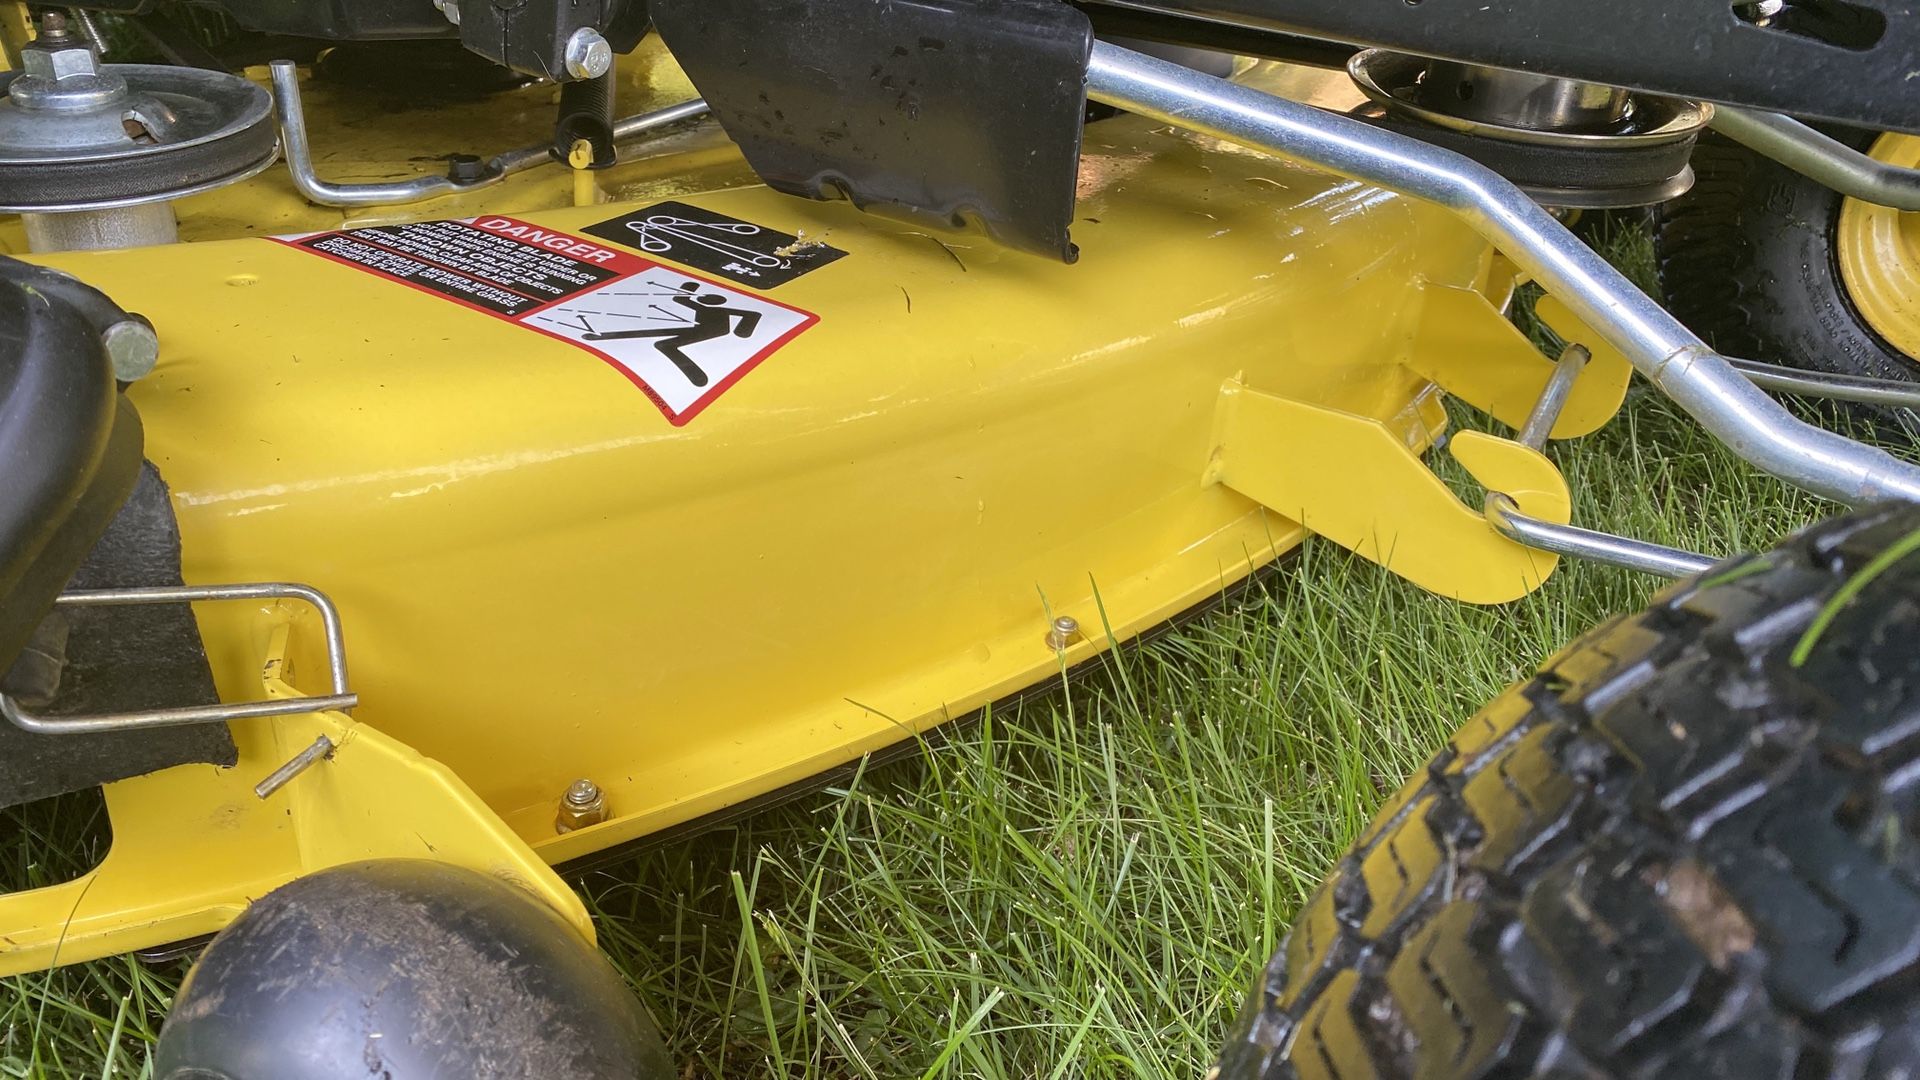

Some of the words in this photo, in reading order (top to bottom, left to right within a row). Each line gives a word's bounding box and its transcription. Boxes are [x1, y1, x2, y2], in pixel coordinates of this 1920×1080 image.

[350, 231, 379, 240] THAT
[412, 250, 462, 267] THROWN
[474, 270, 515, 284] BLADE
[395, 230, 470, 254] THROWN
[467, 252, 549, 280] OBJECTS
[410, 228, 451, 240] MOWER
[450, 239, 484, 250] WHEN
[482, 249, 525, 263] ENGINE
[534, 266, 587, 284] RUNNING
[436, 222, 519, 247] ROTATING
[518, 246, 578, 266] BLADE
[455, 234, 495, 247] HANDS
[510, 251, 540, 261] FEET
[538, 260, 578, 274] UNDER
[479, 219, 616, 263] DANGER
[373, 263, 412, 276] PLACE
[373, 250, 428, 269] OPERATE
[425, 267, 472, 284] MOWER
[470, 282, 527, 303] WITHOUT
[381, 259, 420, 272] CHUTE
[435, 277, 478, 292] ENTIRE
[476, 291, 518, 306] GRASS
[437, 251, 474, 263] CLEAR
[471, 262, 502, 273] AREA
[513, 276, 564, 294] OBJECTS
